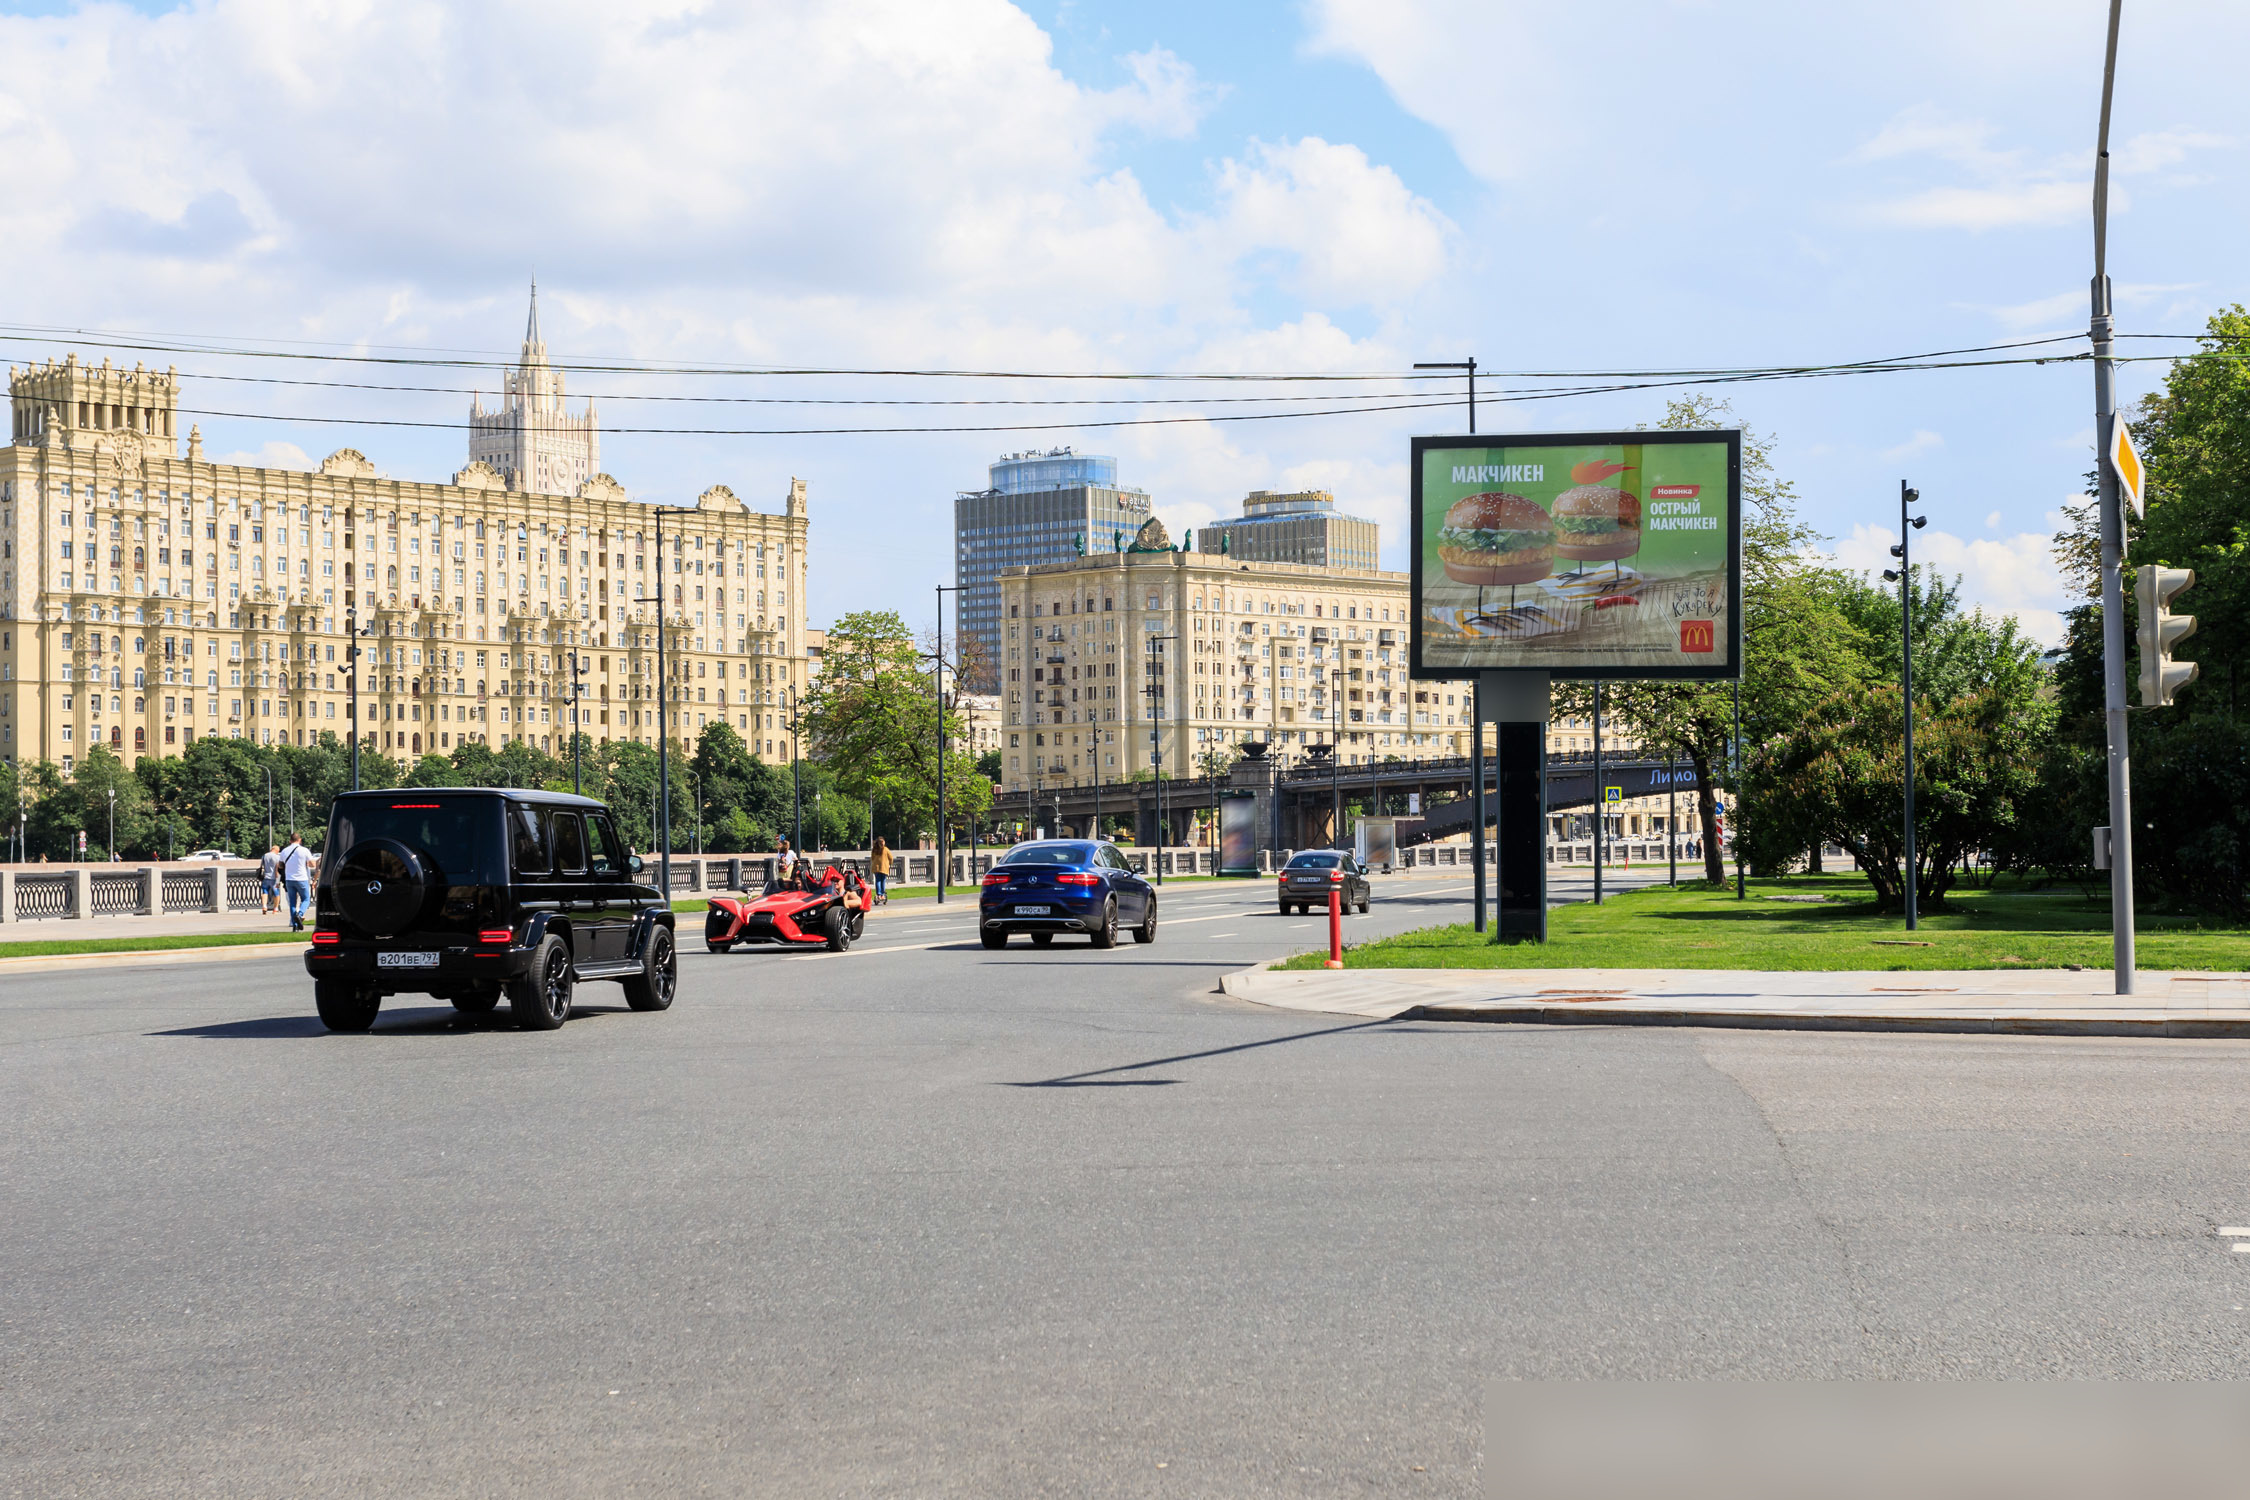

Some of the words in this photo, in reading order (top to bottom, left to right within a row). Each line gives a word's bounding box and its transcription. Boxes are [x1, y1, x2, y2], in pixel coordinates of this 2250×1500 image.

[1452, 464, 1544, 484] МАКЧИКЕН
[1650, 498, 1701, 515] ОСТРЫЙ
[1650, 517, 1717, 530] МАКЧИКЕН
